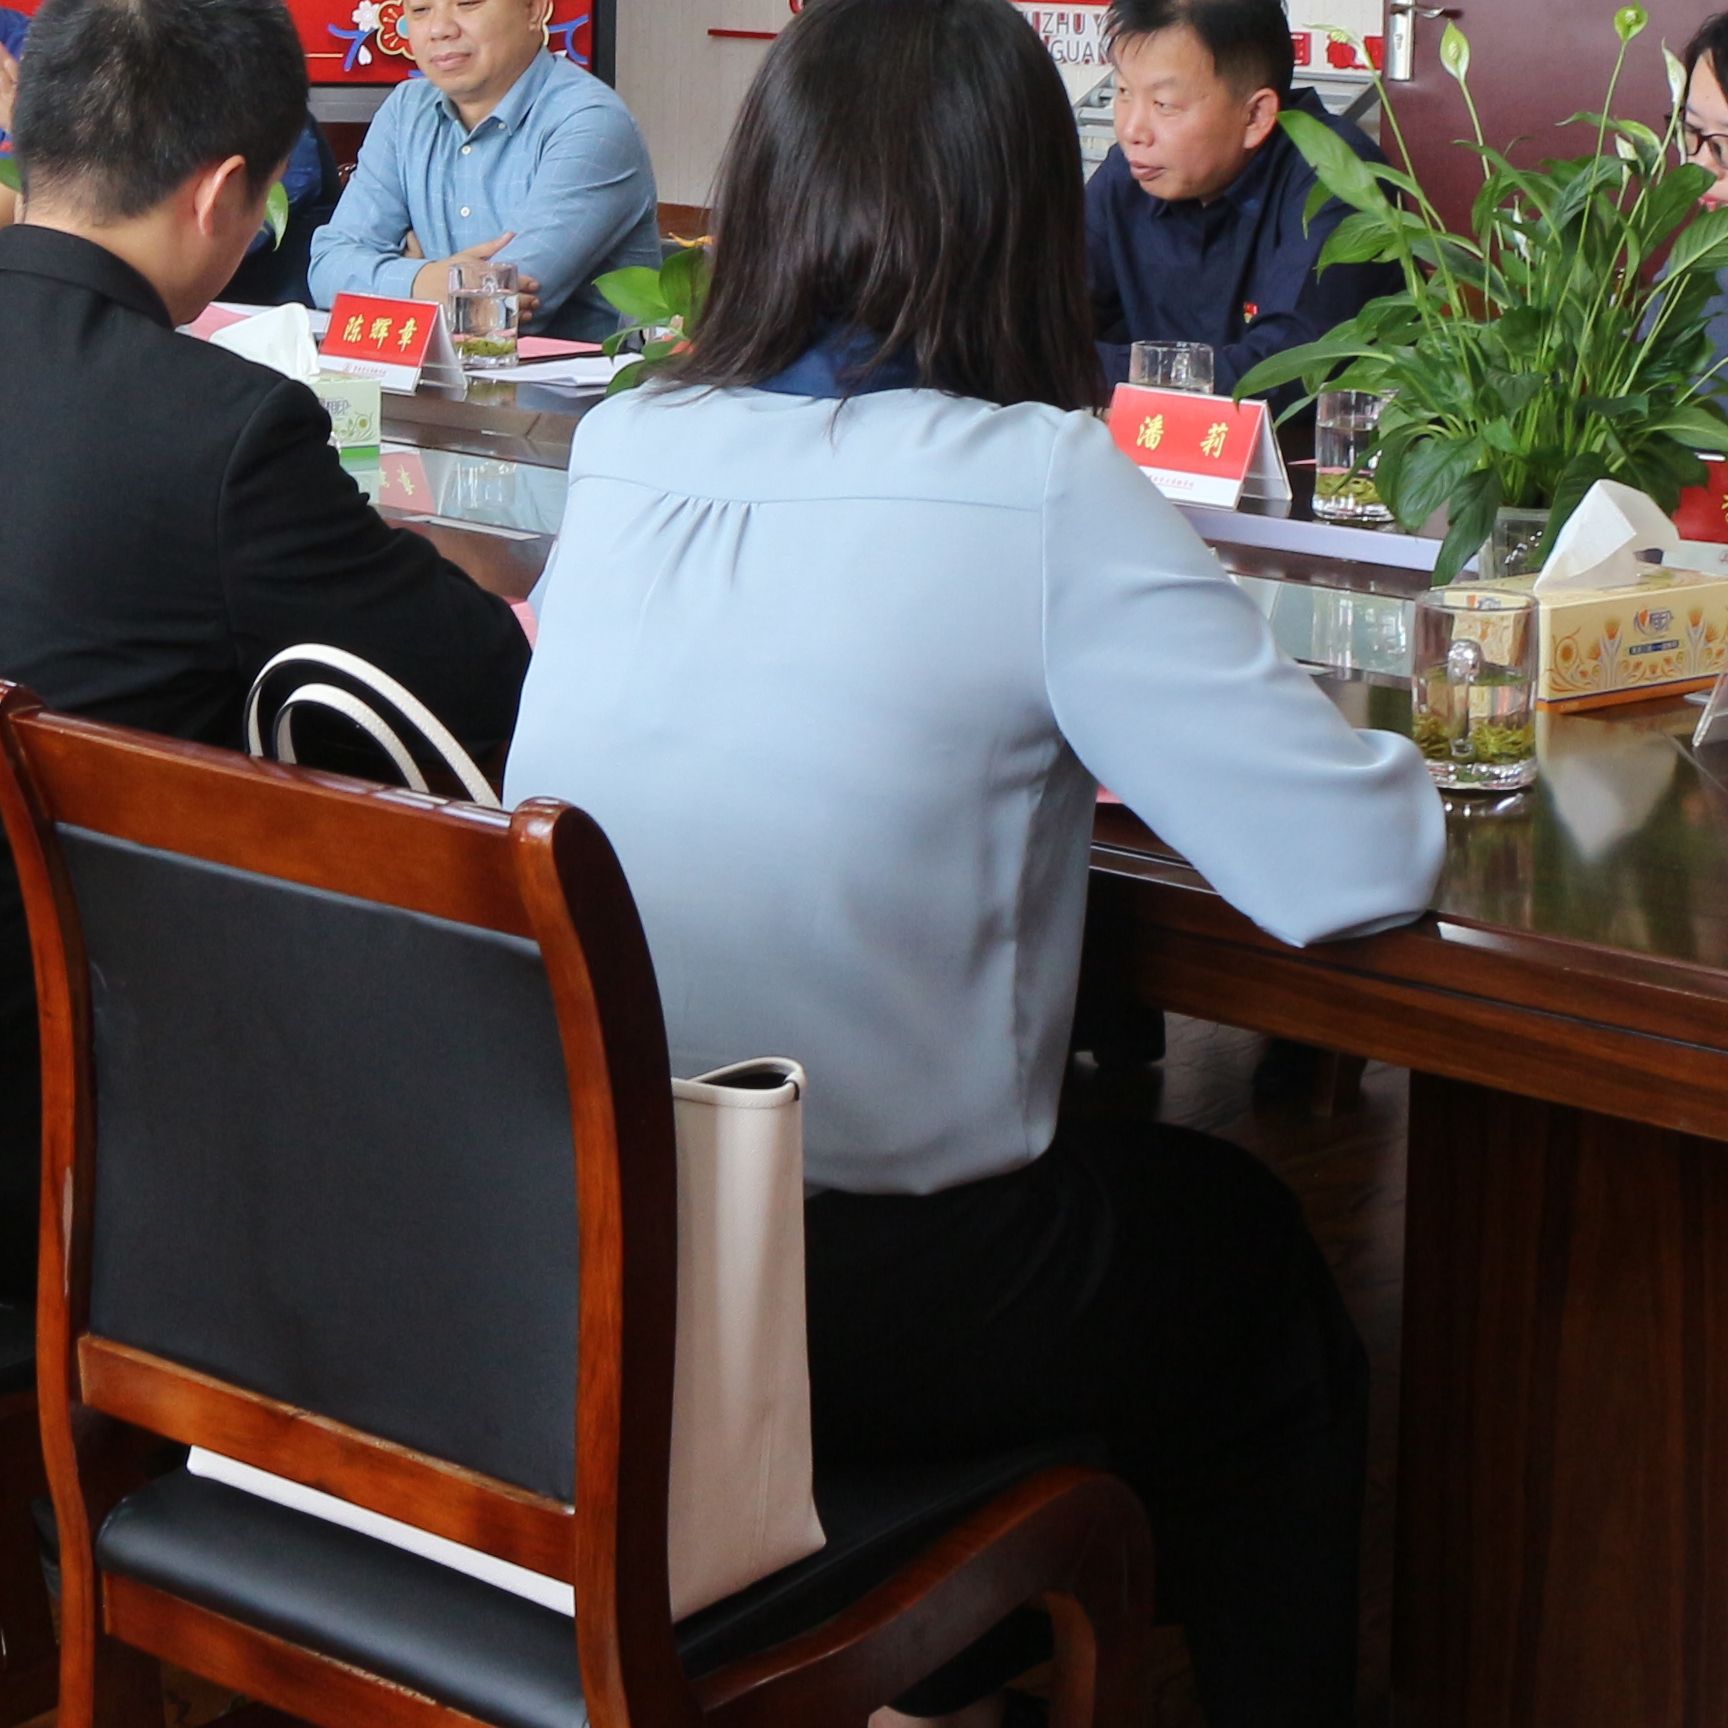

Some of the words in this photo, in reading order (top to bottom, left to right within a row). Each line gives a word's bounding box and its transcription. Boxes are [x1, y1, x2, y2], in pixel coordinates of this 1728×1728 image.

[343, 314, 419, 353] 陈辉章
[1135, 414, 1230, 459] 潘莉
